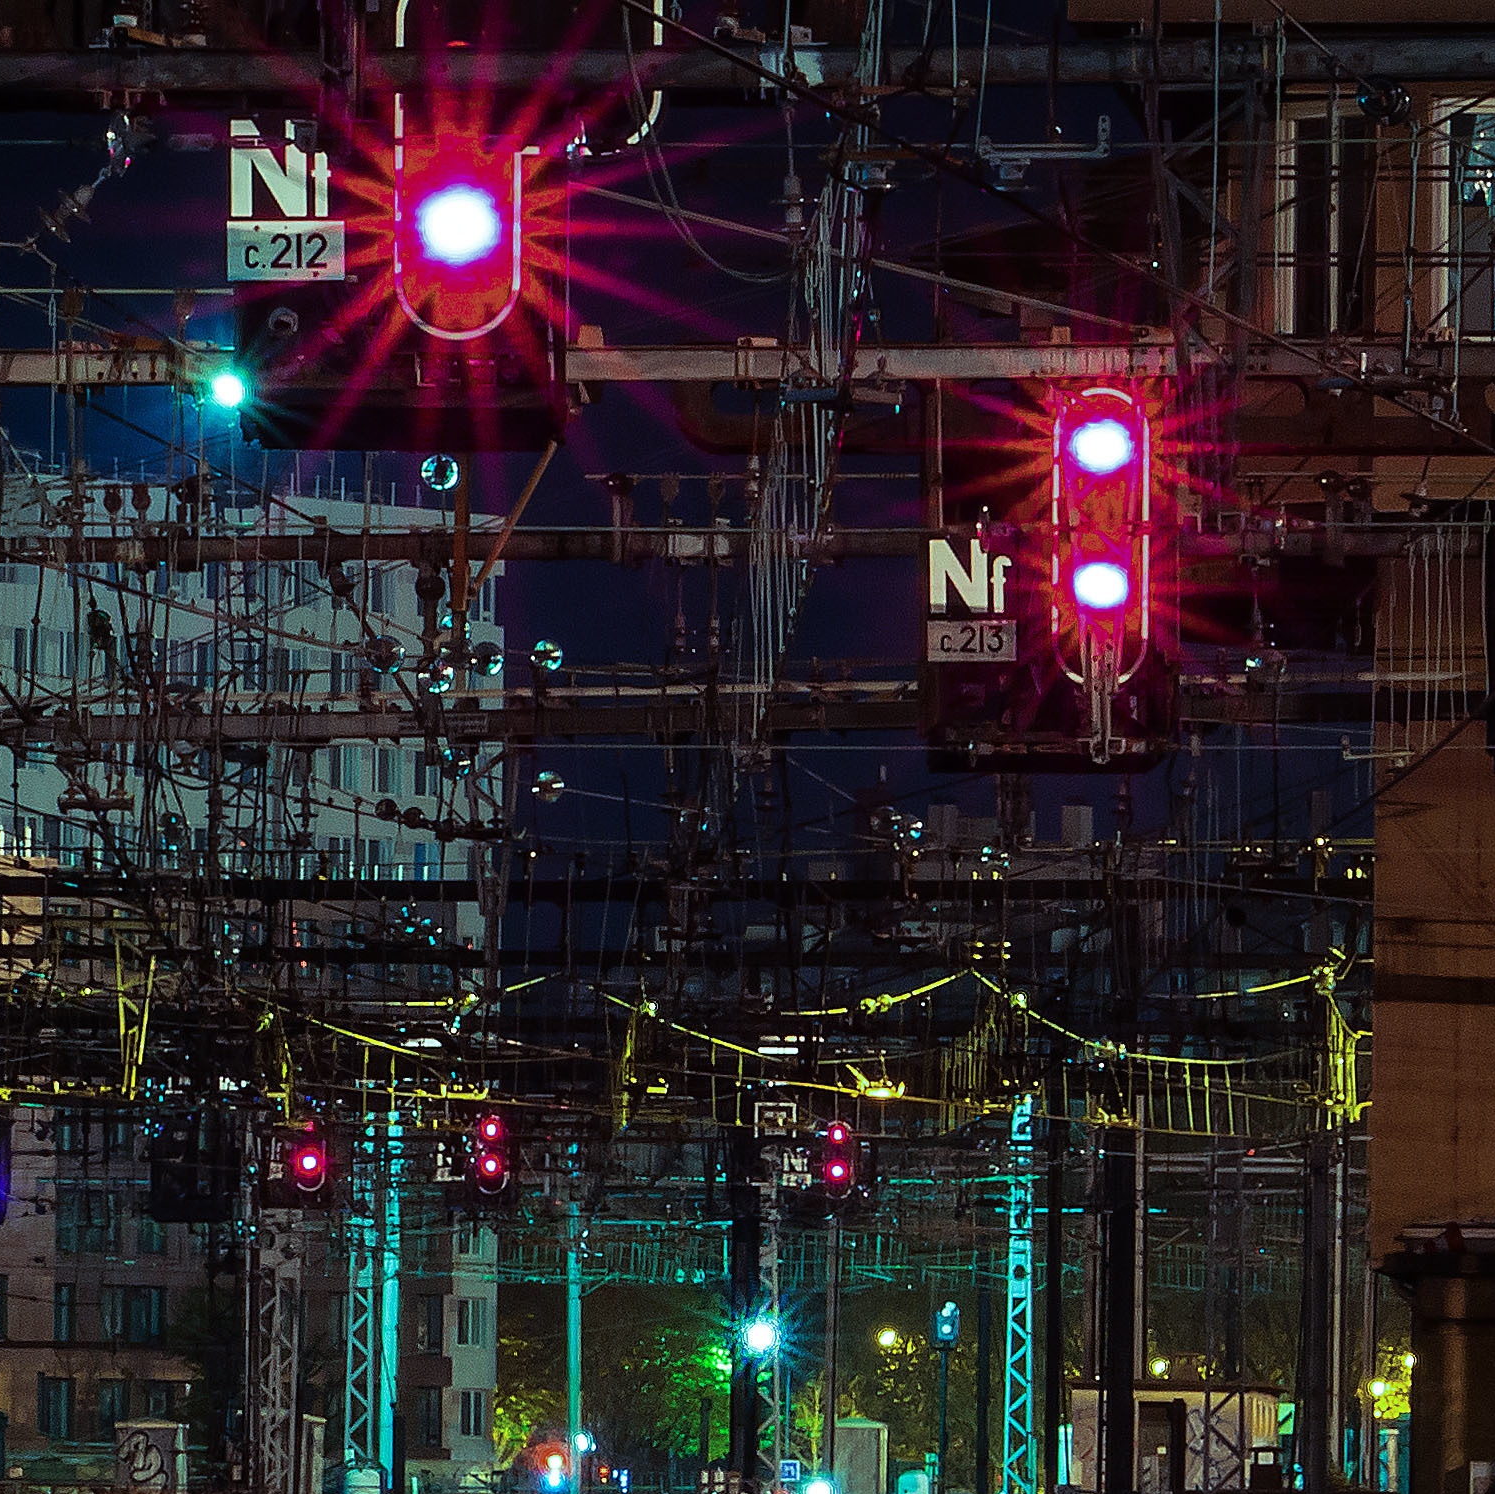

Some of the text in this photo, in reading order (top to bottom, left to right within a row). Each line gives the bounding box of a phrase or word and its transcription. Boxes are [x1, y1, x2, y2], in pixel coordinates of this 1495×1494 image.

[245, 233, 328, 269] c.212
[928, 538, 1012, 613] Nf
[940, 625, 1003, 653] c.213
